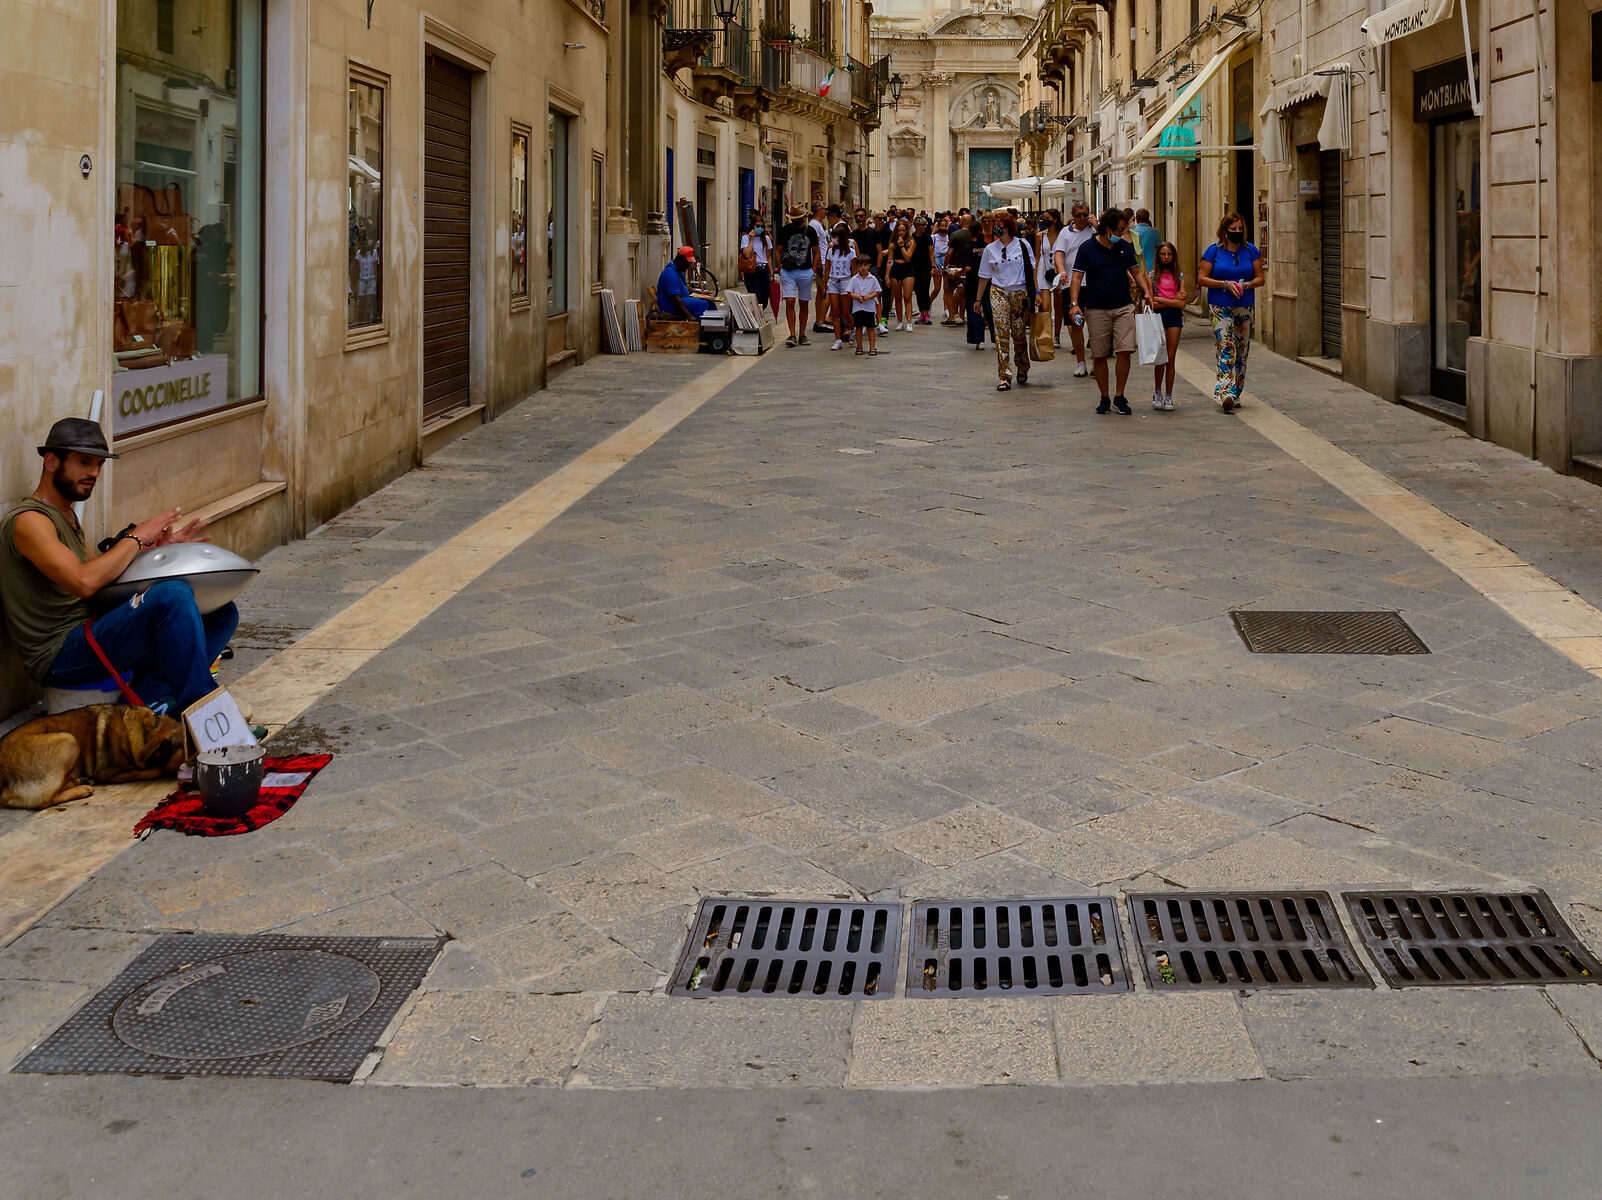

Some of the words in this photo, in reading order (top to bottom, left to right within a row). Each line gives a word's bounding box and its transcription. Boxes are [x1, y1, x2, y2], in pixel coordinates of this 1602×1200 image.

[1384, 9, 1424, 41] MONTBLANC
[119, 372, 211, 417] COCCINELLE
[204, 711, 230, 743] CD
